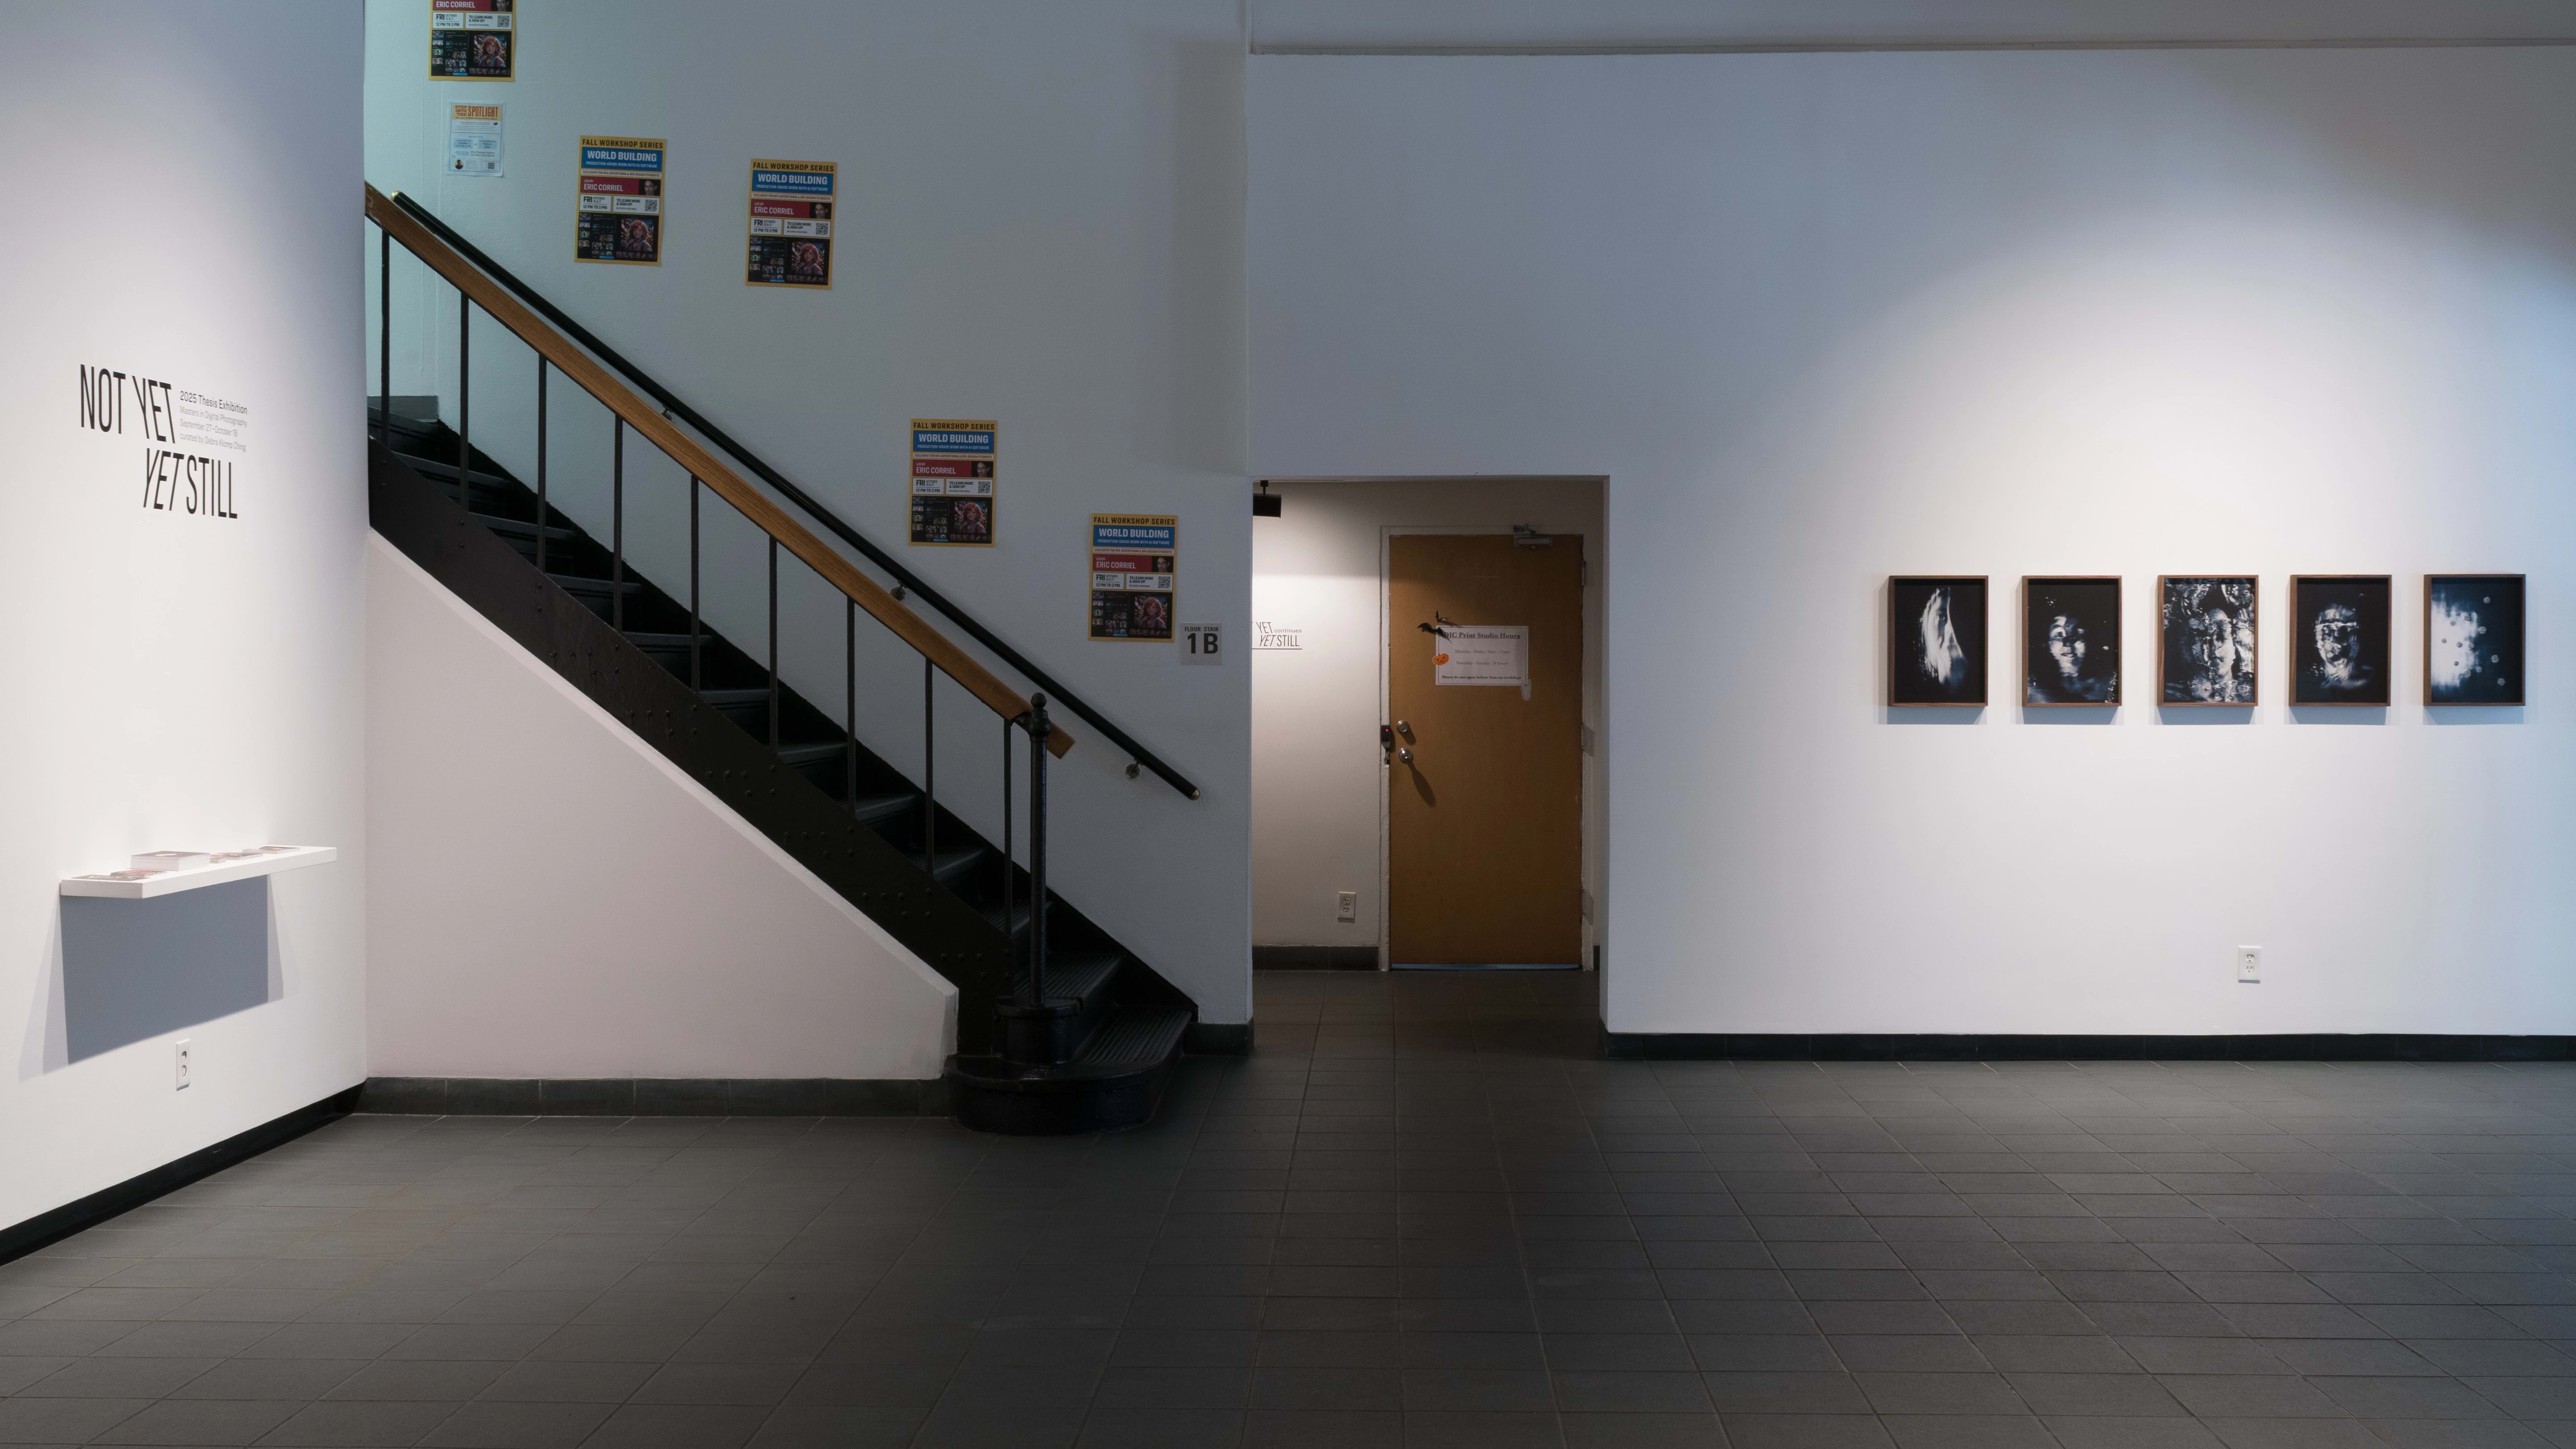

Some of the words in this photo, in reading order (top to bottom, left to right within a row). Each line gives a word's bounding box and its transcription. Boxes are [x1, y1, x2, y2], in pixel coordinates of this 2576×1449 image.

[468, 106, 498, 117] SPOTLIGHT
[587, 151, 616, 159] WORLD
[618, 152, 656, 161] BUILDING
[758, 174, 787, 183] WORLD
[789, 175, 827, 184] BUILDING
[81, 364, 126, 434] NOT
[132, 375, 175, 444] YET
[180, 391, 196, 403] 2025
[199, 395, 217, 408] Thesis
[219, 399, 247, 414] Exhibition
[180, 406, 199, 416] Masters
[200, 410, 204, 418] in
[205, 411, 219, 421] Digital
[220, 414, 247, 428] Photography
[180, 419, 205, 430] September
[918, 434, 948, 442] WORLD
[950, 435, 988, 443] BUILDING
[143, 448, 184, 511] YET
[186, 455, 238, 519] STILL
[1099, 528, 1128, 537] WORLD
[1130, 529, 1169, 538] BUILDING
[1256, 622, 1273, 633] YET
[1187, 633, 1196, 654] 1
[1203, 633, 1218, 654] B
[1259, 635, 1276, 646] YET
[1277, 635, 1300, 646] STILL
